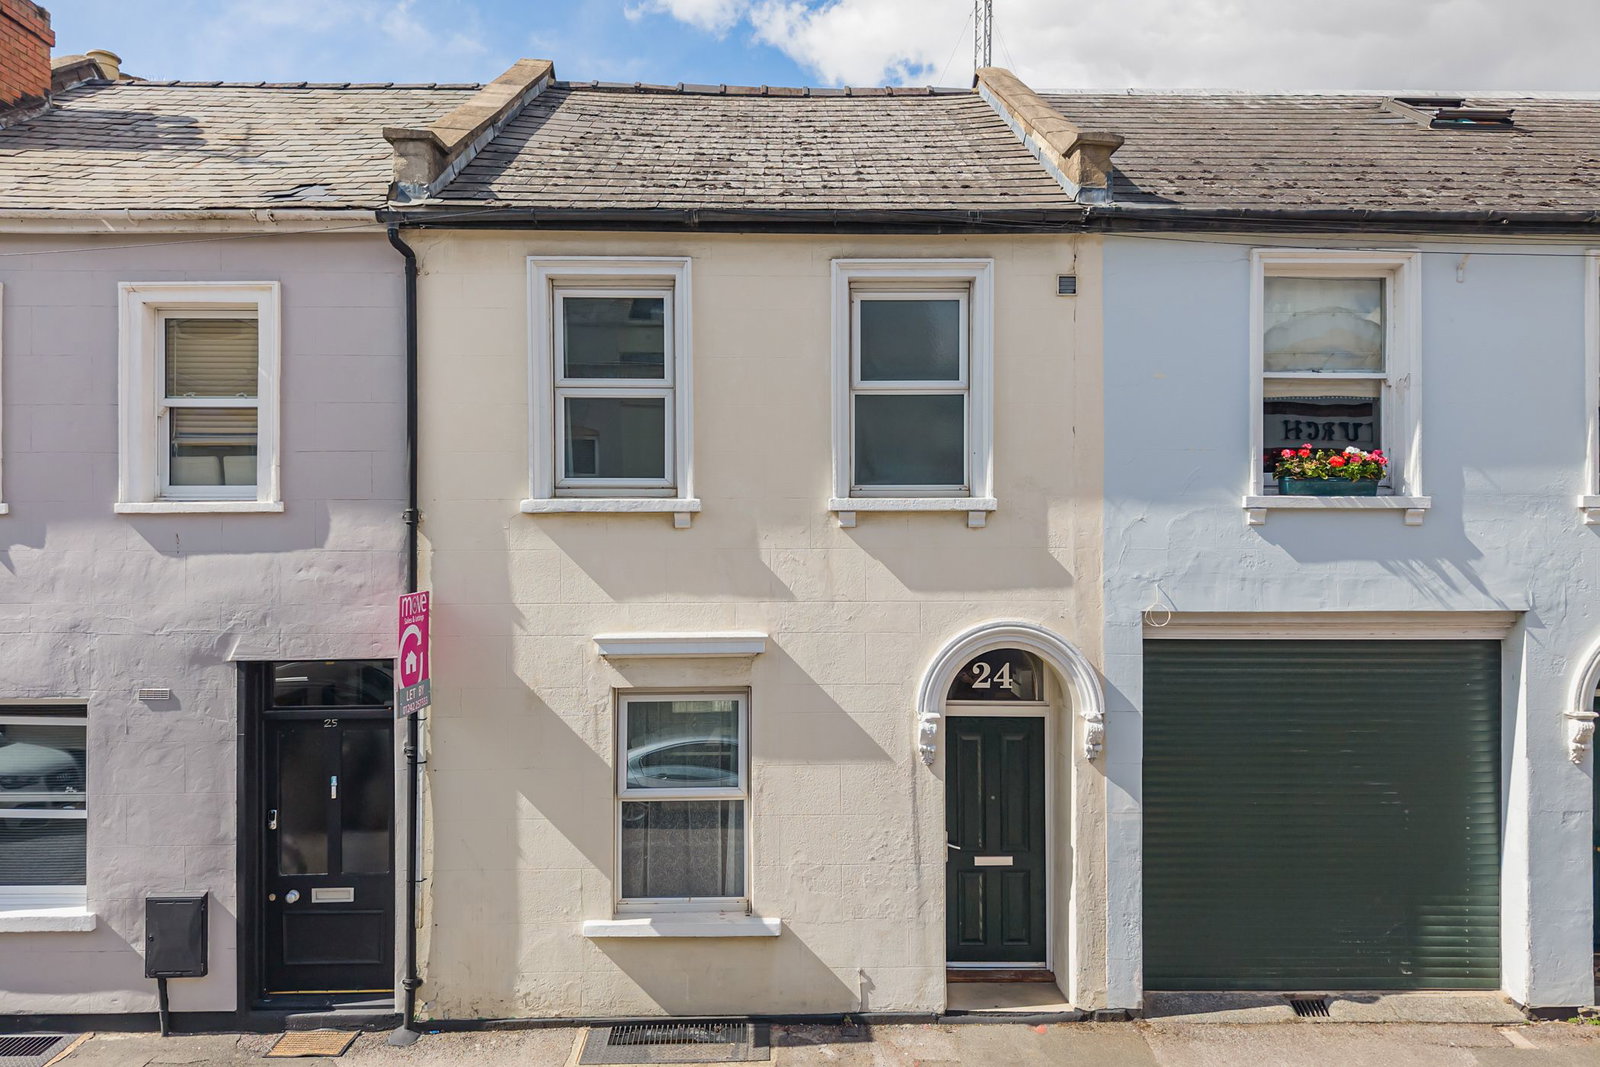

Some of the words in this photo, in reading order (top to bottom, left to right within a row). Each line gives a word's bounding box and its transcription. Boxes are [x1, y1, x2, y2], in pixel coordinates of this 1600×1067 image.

[402, 594, 427, 617] move
[971, 662, 1014, 689] 24
[406, 688, 416, 701] LET
[418, 685, 424, 697] BY
[323, 718, 338, 728] 25
